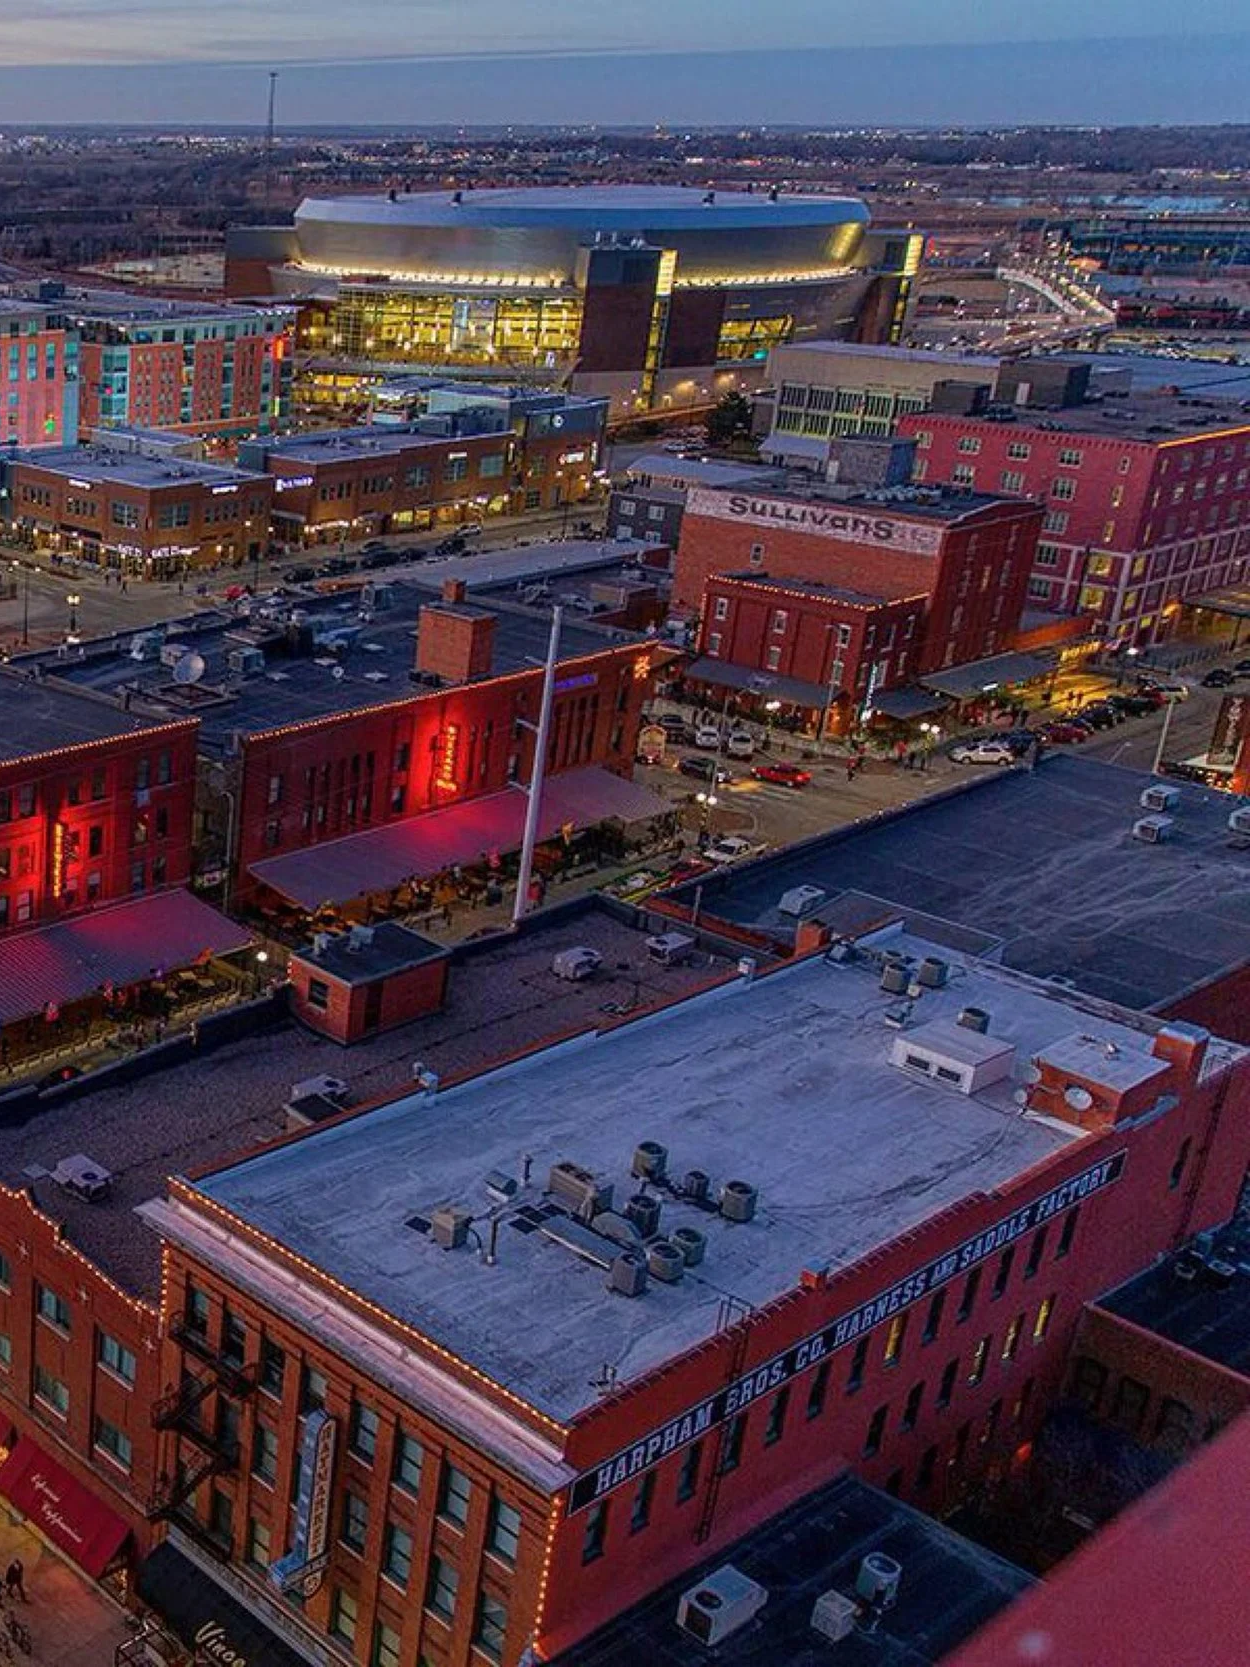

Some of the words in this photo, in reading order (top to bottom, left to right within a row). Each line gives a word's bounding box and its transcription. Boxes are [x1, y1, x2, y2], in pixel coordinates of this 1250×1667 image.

[595, 1402, 713, 1494] HARPHAM
[724, 1361, 787, 1414] BROS.
[796, 1336, 826, 1370] CO.
[833, 1272, 927, 1346] HARNESS
[960, 1210, 1030, 1267] SADDLE
[1035, 1163, 1112, 1222] FACTORY
